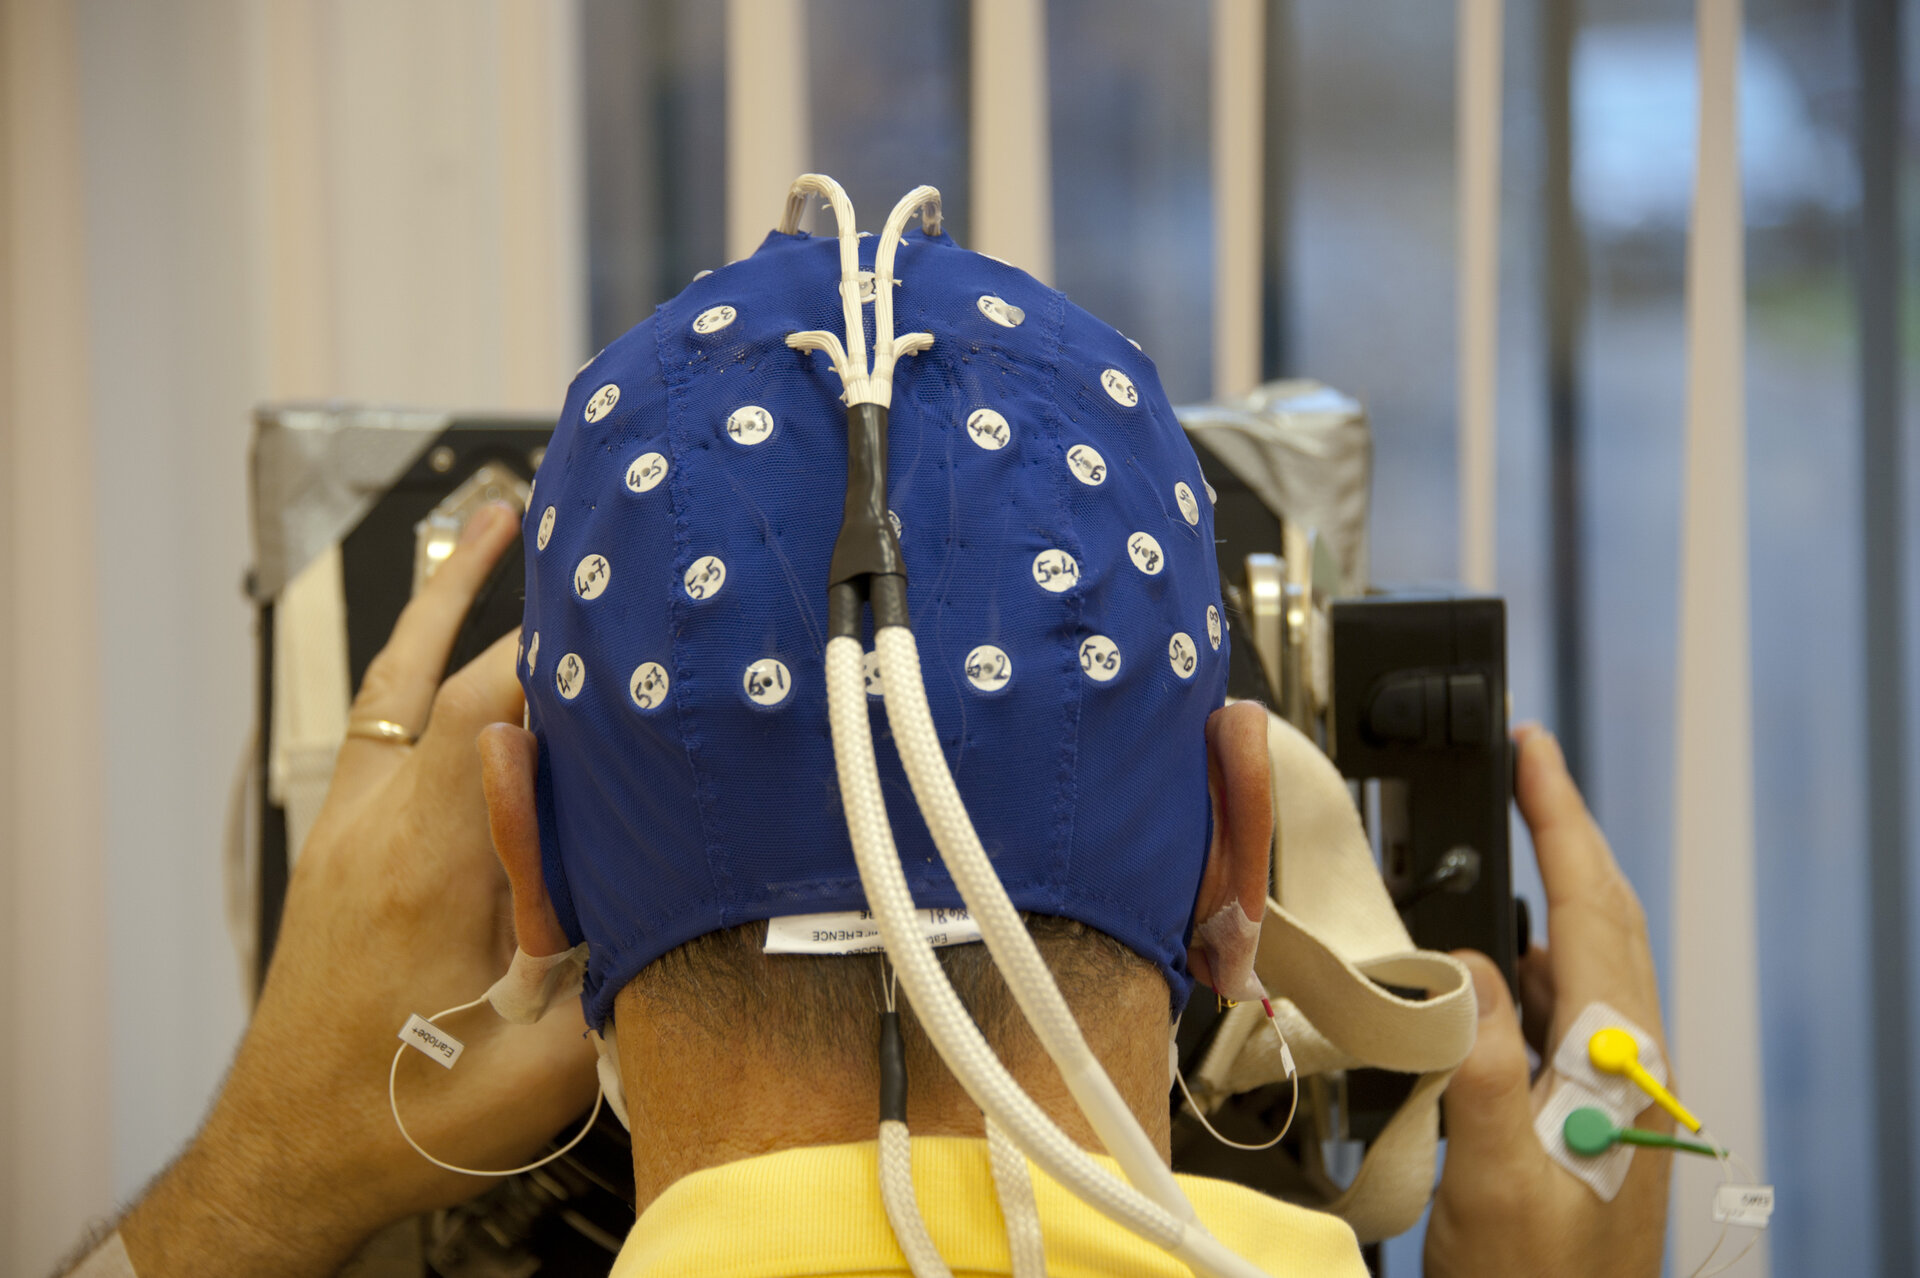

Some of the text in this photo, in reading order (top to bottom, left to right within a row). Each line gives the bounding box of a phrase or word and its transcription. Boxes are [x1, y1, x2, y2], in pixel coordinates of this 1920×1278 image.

[697, 307, 733, 332] 33
[1105, 370, 1137, 403] 34
[588, 387, 617, 422] 35
[728, 410, 768, 437] 43
[969, 414, 1008, 447] 44
[629, 455, 663, 488] 45
[1070, 449, 1105, 482] 46
[1038, 555, 1077, 583] 54
[1131, 536, 1159, 571] 48
[577, 557, 606, 596] 47
[687, 558, 721, 599] 55
[967, 652, 1009, 680] 62
[1081, 644, 1119, 671] 56
[1169, 640, 1194, 672] 50
[557, 655, 579, 694] 49
[635, 666, 665, 709] 57
[748, 664, 784, 697] 61
[412, 1027, 456, 1058] Earlobe+
